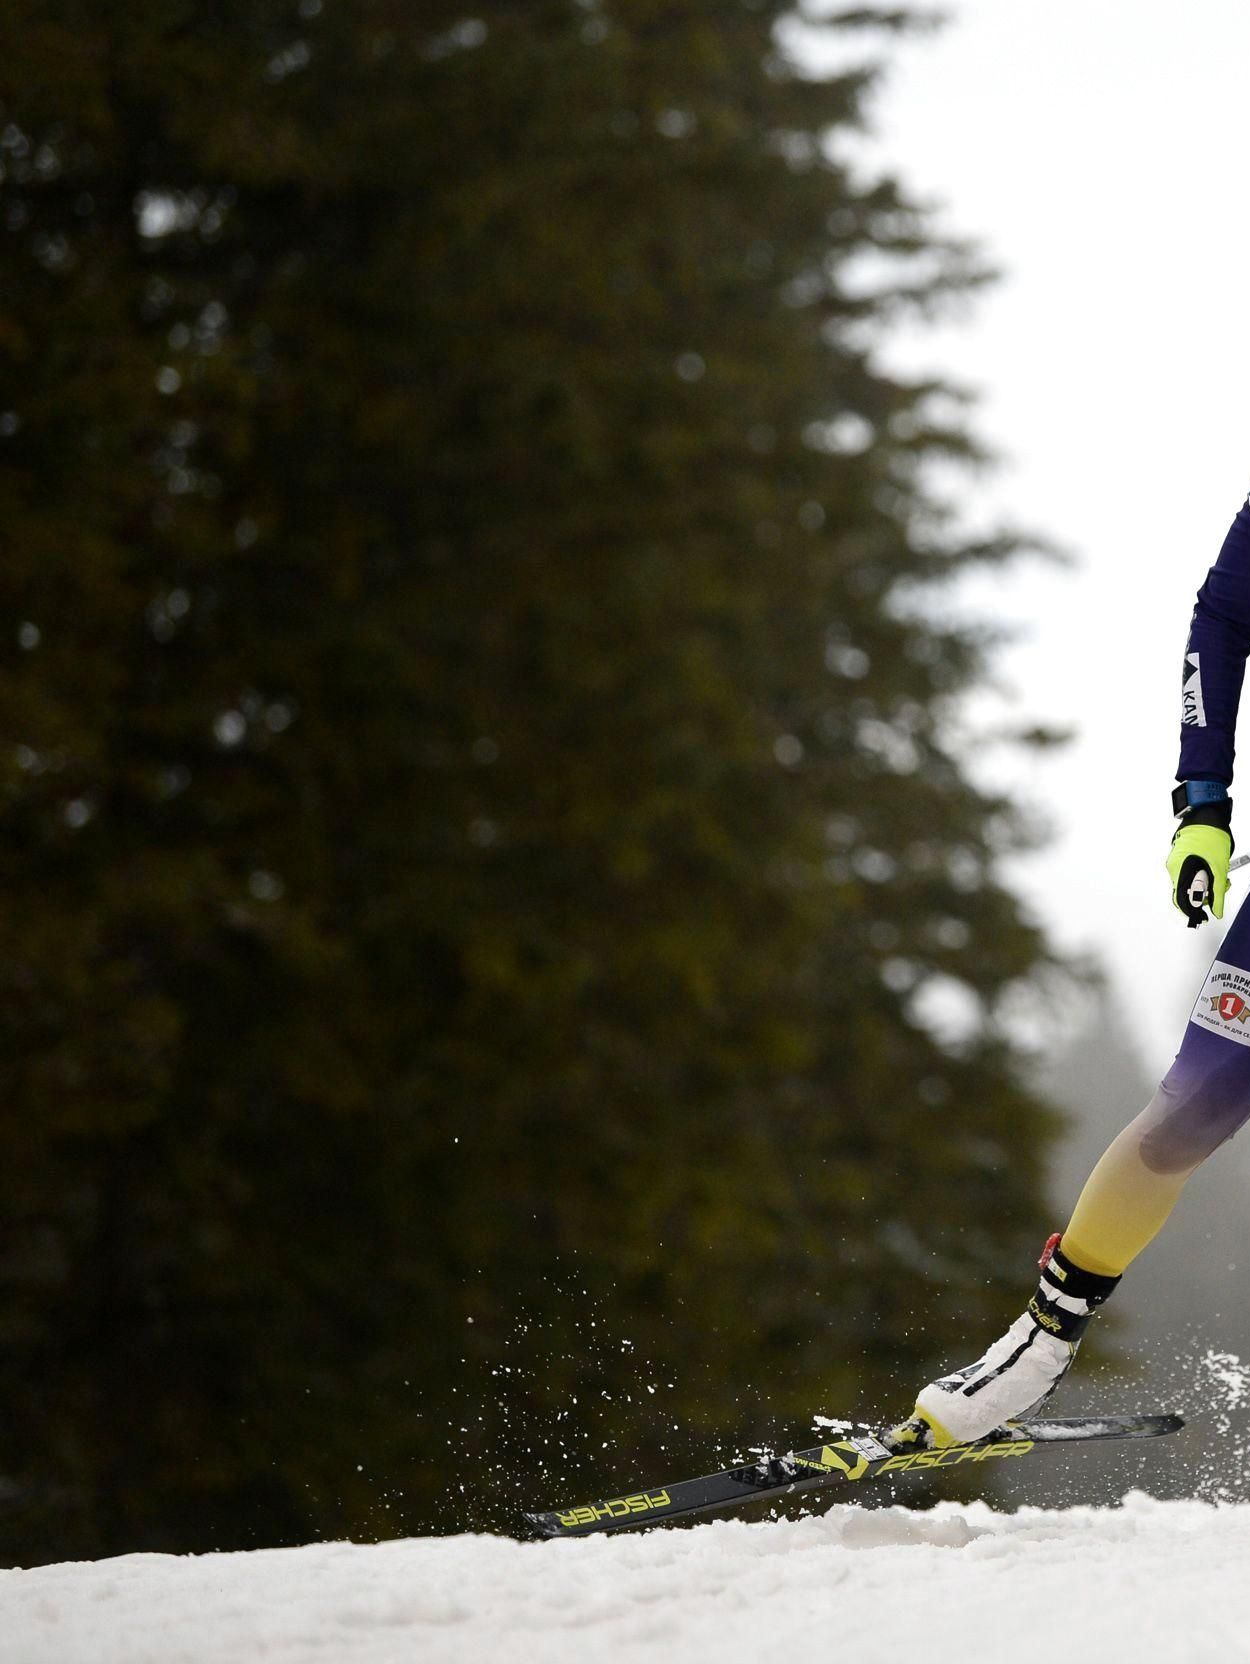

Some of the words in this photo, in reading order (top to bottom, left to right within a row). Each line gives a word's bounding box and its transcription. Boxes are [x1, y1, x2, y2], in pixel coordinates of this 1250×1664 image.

[1211, 973, 1232, 983] ПЕРША
[1222, 997, 1236, 1016] 1
[555, 1489, 671, 1527] FISCHER
